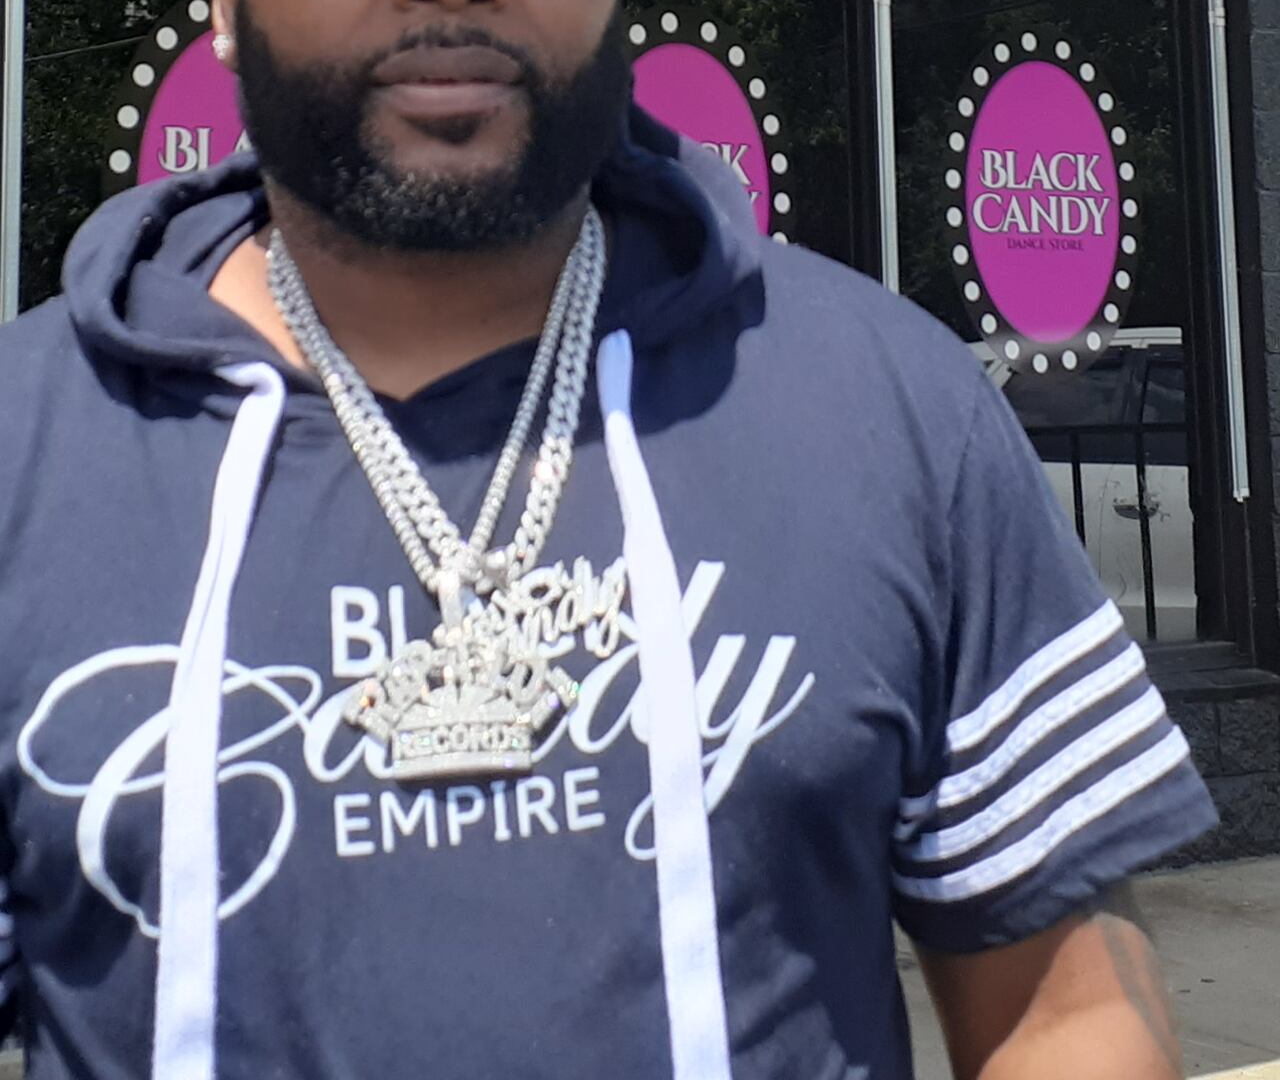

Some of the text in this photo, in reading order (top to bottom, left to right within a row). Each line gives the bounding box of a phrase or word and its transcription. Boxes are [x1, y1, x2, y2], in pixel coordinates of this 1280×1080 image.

[979, 149, 1104, 193] BLACK
[972, 192, 1111, 236] CANDY
[333, 767, 606, 858] EMPIRE
